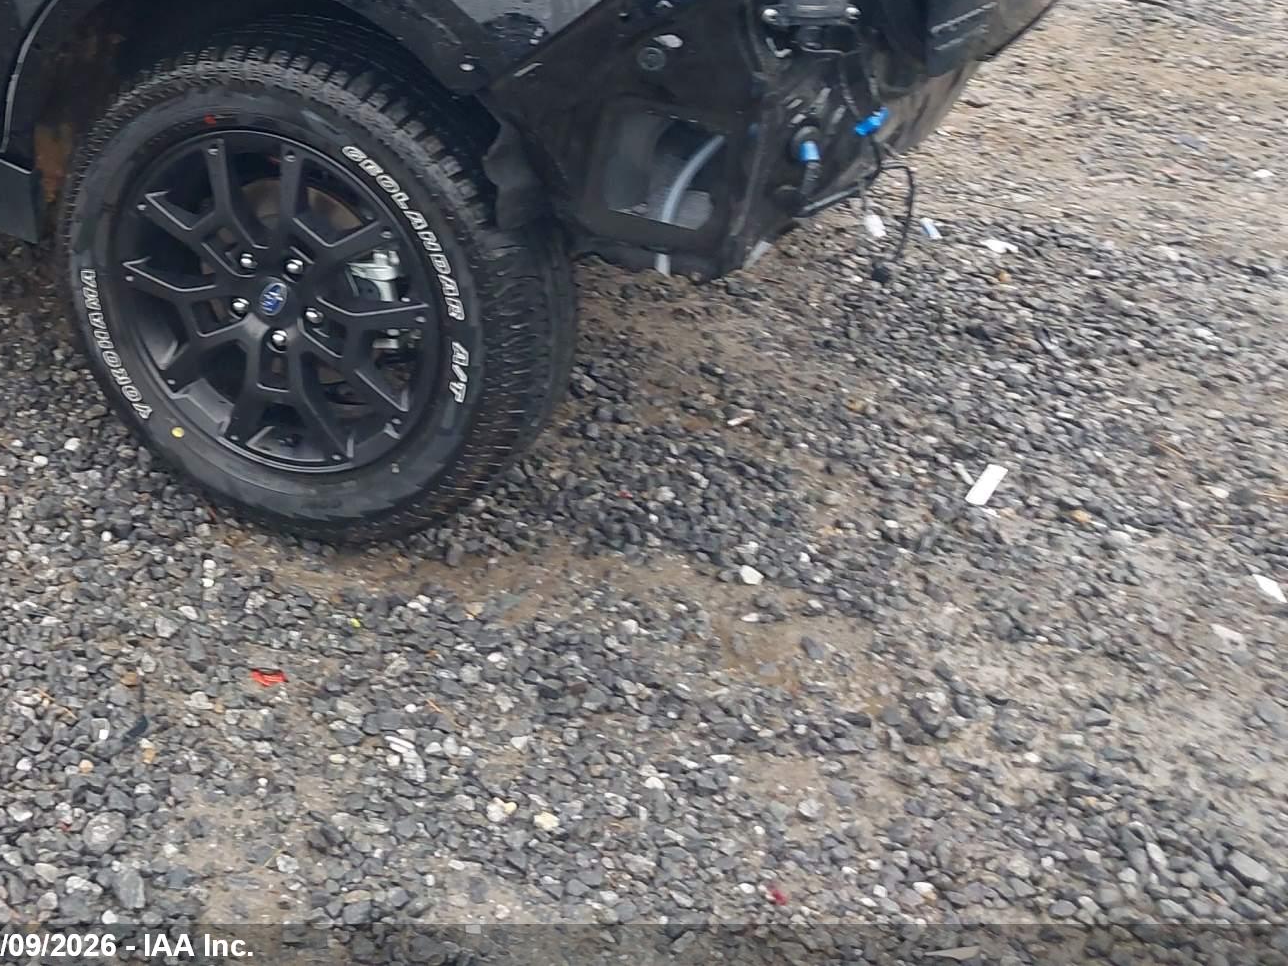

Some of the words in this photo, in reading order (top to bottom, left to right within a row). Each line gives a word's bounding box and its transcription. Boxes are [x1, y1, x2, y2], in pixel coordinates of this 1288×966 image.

[80, 268, 153, 419] YOKOHAMA
[341, 145, 465, 321] GEOLANDAR
[448, 341, 470, 403] A/T
